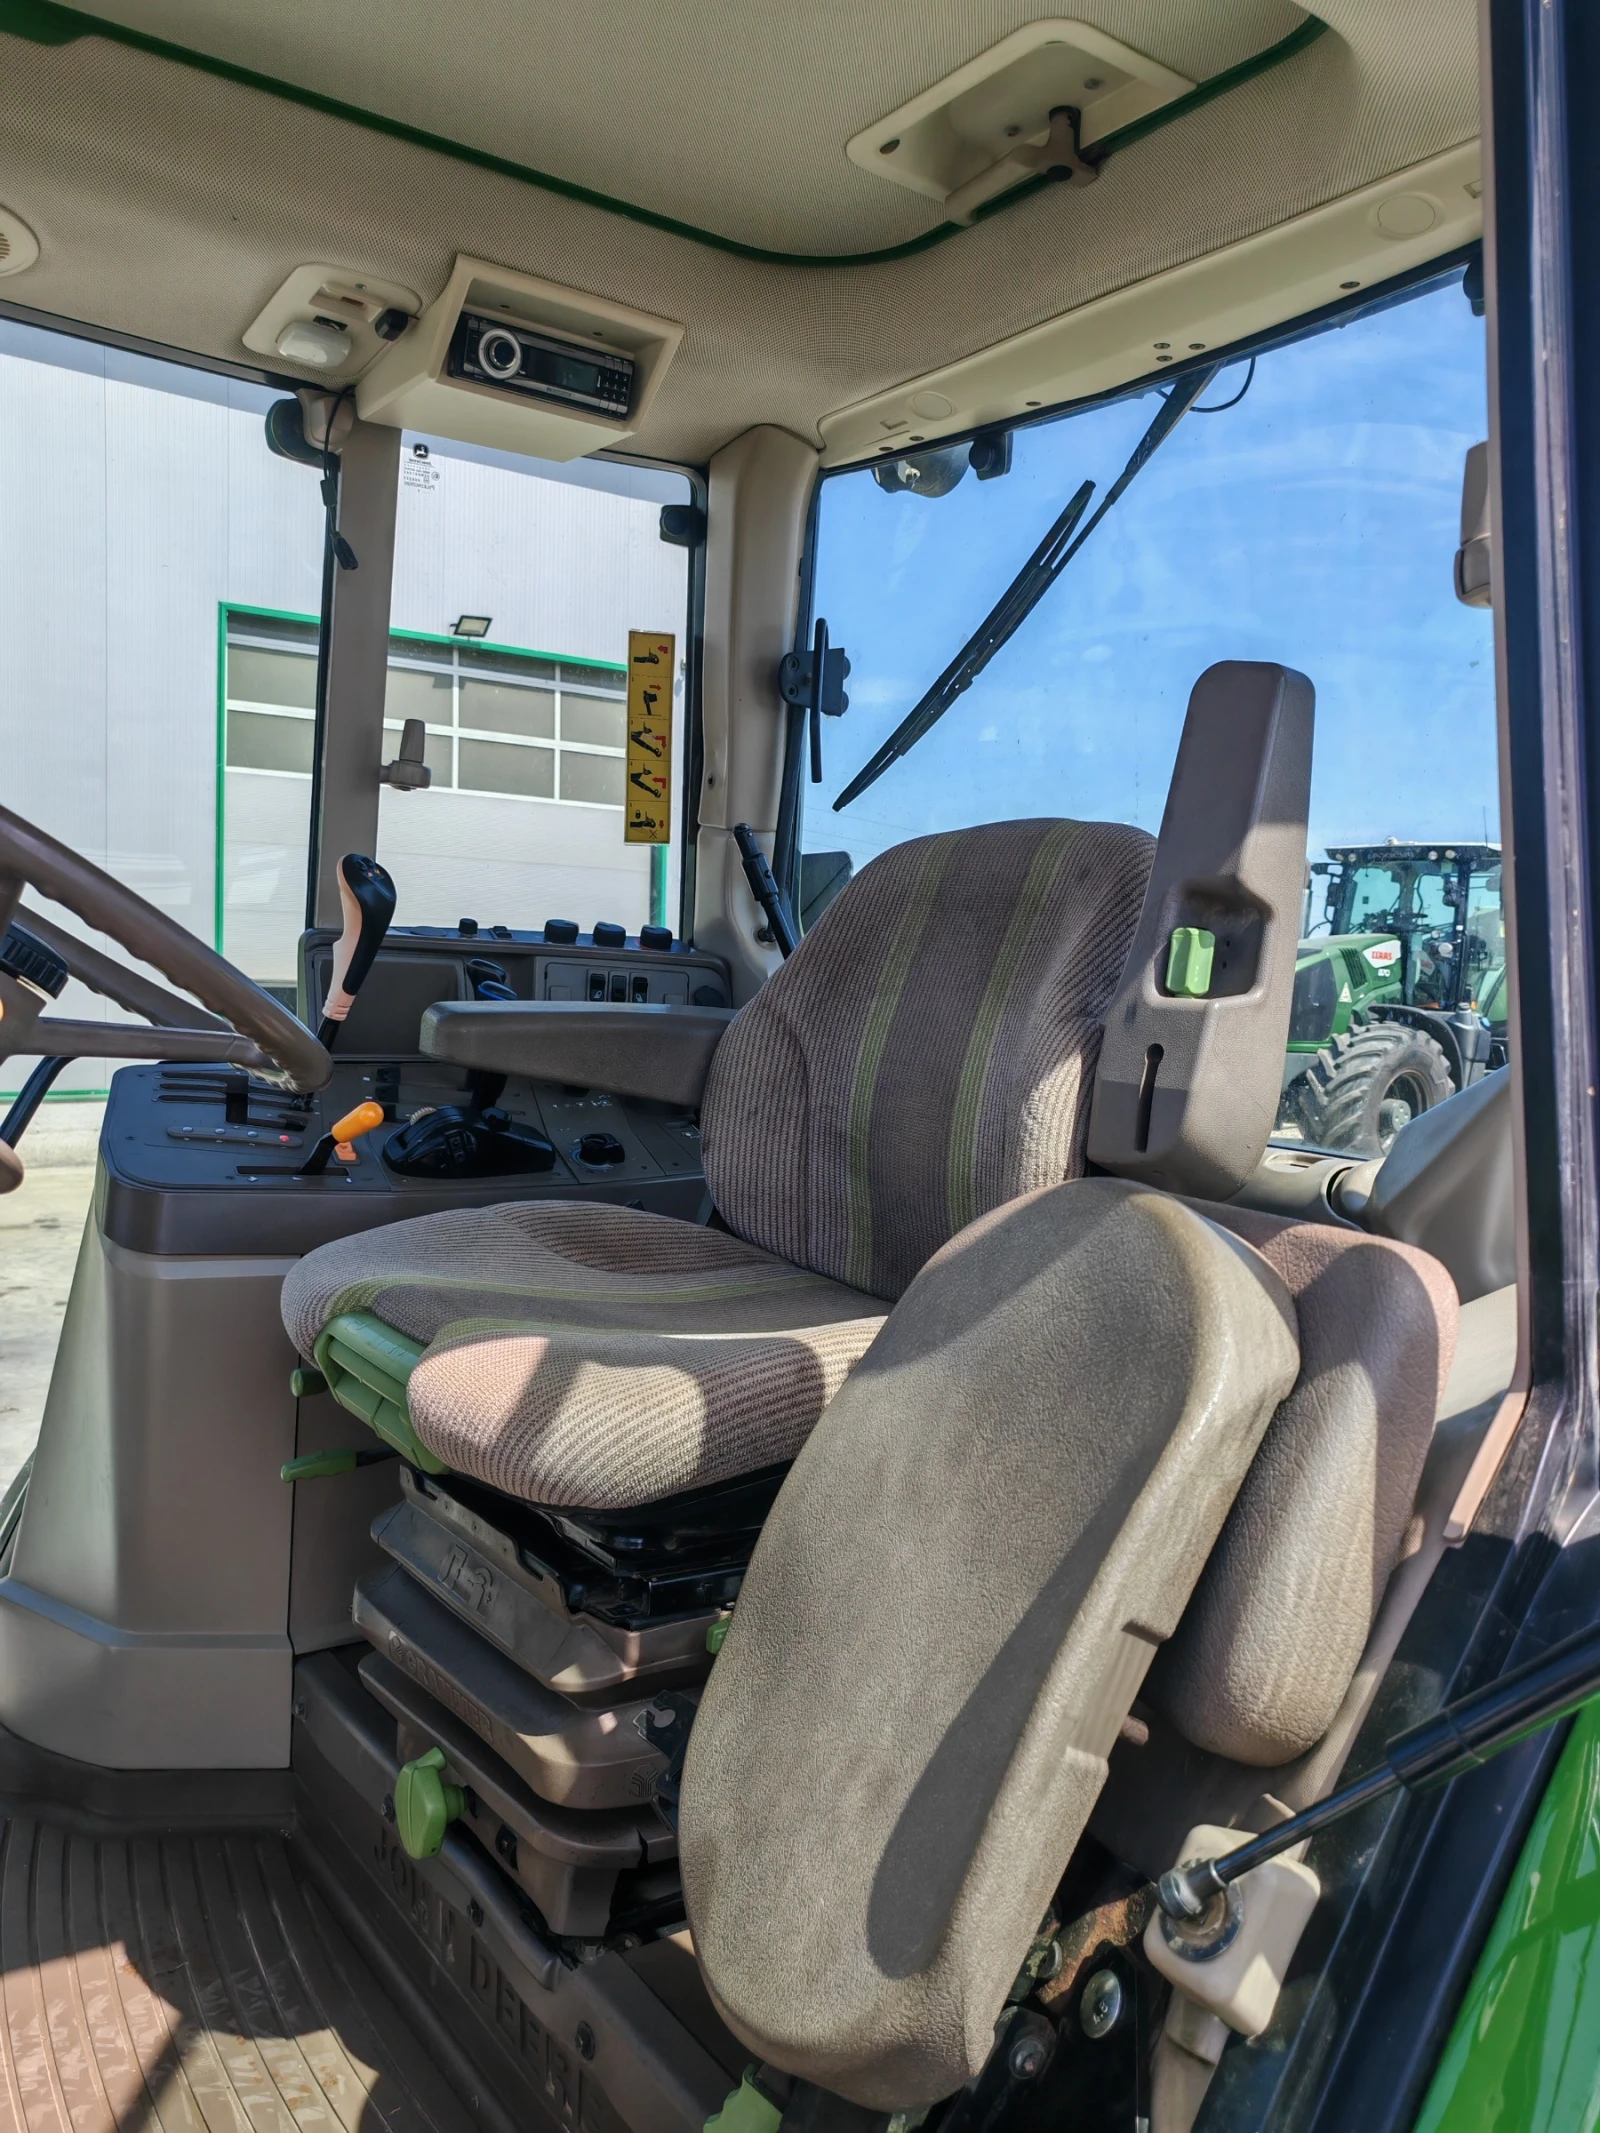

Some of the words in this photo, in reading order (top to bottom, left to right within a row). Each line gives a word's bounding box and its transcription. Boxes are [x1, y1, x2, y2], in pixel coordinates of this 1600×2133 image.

[1372, 951, 1393, 961] CLAAS
[373, 1826, 456, 1964] JOHN
[470, 1934, 604, 2133] DEERE
[1092, 2001, 1109, 2025] 4.8
